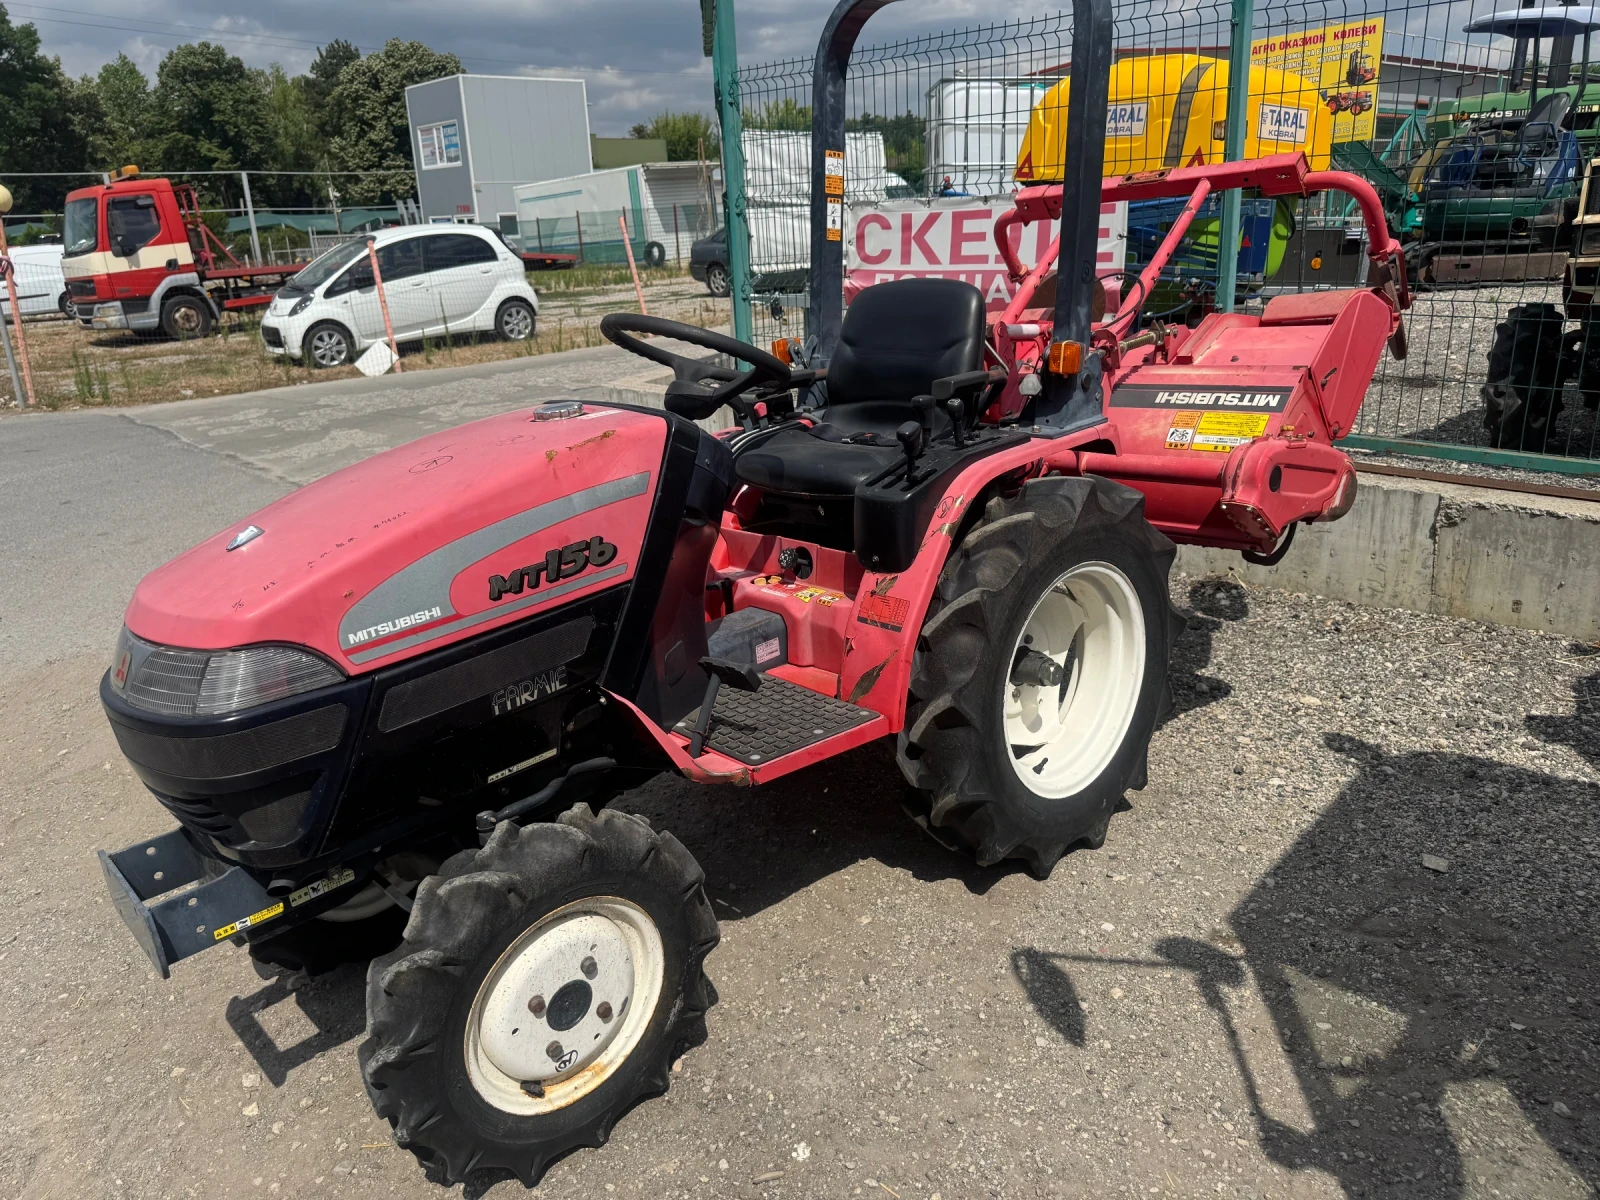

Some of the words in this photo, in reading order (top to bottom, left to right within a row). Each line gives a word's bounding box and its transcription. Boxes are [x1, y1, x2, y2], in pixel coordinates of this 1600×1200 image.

[1252, 43, 1276, 56] АГРО
[1279, 33, 1325, 51] ОКАЗИОН
[1333, 24, 1377, 41] КОЛЕВИ
[1107, 106, 1144, 124] ARAL
[1269, 109, 1305, 129] TARAL
[1107, 126, 1131, 134] OBRA
[1268, 130, 1295, 139] KOBRA
[1155, 391, 1281, 407] MITSUBISHI
[488, 535, 618, 601] MT156
[348, 606, 442, 645] MITSUBISHI
[491, 666, 568, 716] FARMIE
